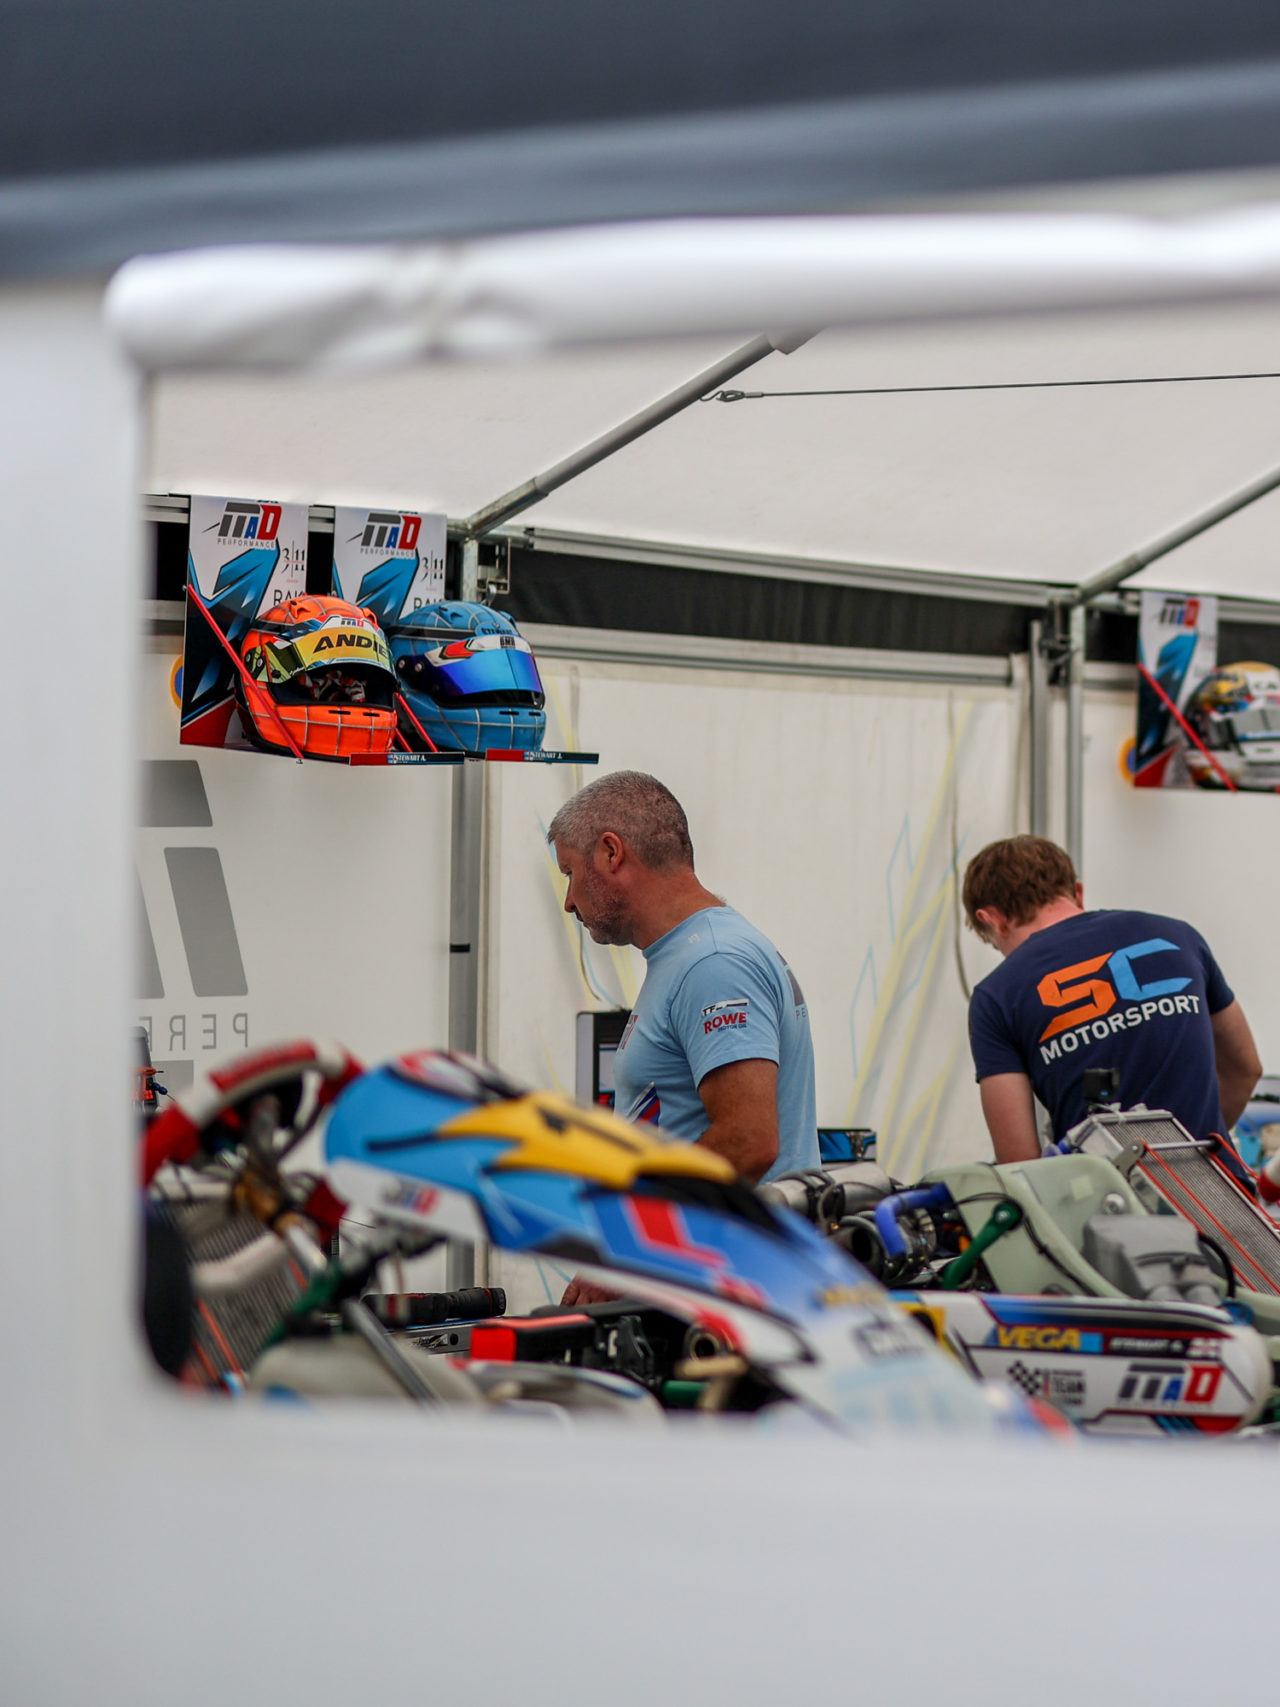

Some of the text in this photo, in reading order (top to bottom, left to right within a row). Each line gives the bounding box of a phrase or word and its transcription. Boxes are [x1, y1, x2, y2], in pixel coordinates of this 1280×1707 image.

[1036, 937, 1193, 1044] SC
[703, 1011, 748, 1034] ROWE
[1039, 993, 1202, 1066] MOTORSPORT
[996, 1325, 1081, 1352] VEGA
